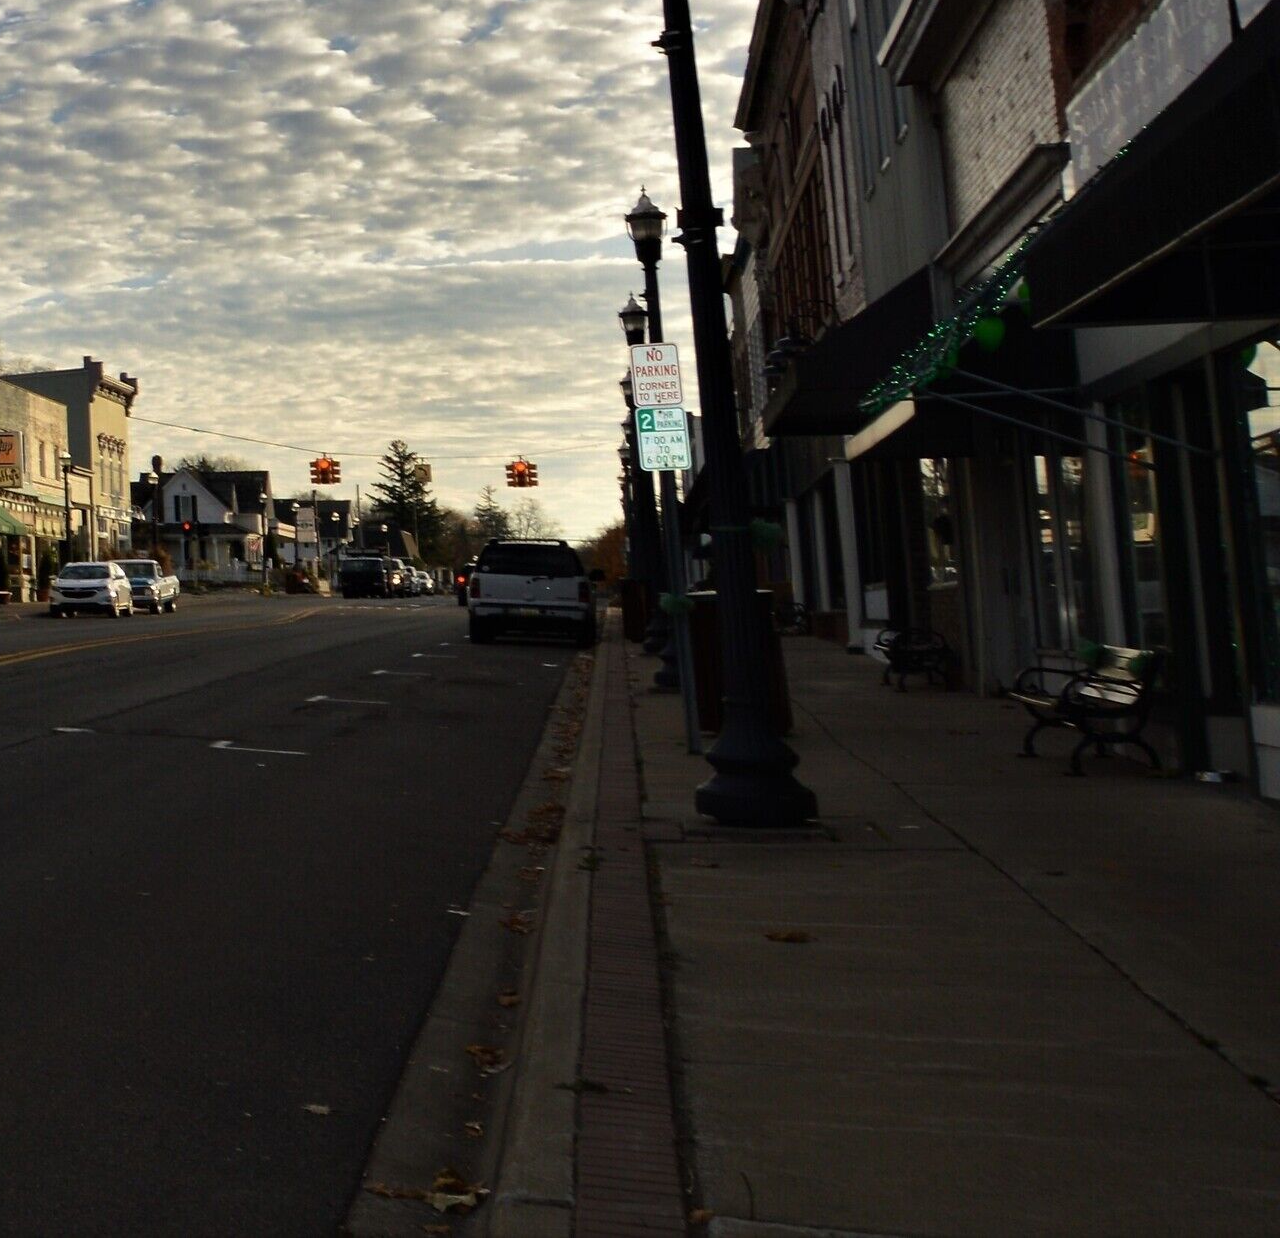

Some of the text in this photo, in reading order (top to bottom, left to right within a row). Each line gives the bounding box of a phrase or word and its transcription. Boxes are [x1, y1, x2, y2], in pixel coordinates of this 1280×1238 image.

[646, 350, 663, 362] NO
[635, 365, 677, 378] PARKING
[639, 381, 677, 391] CORNER
[639, 392, 679, 401] TO HERE
[640, 411, 674, 430] 2 HR
[657, 419, 683, 428] PARKING
[670, 436, 683, 444] AM
[659, 446, 670, 454] TO
[672, 455, 684, 463] PM
